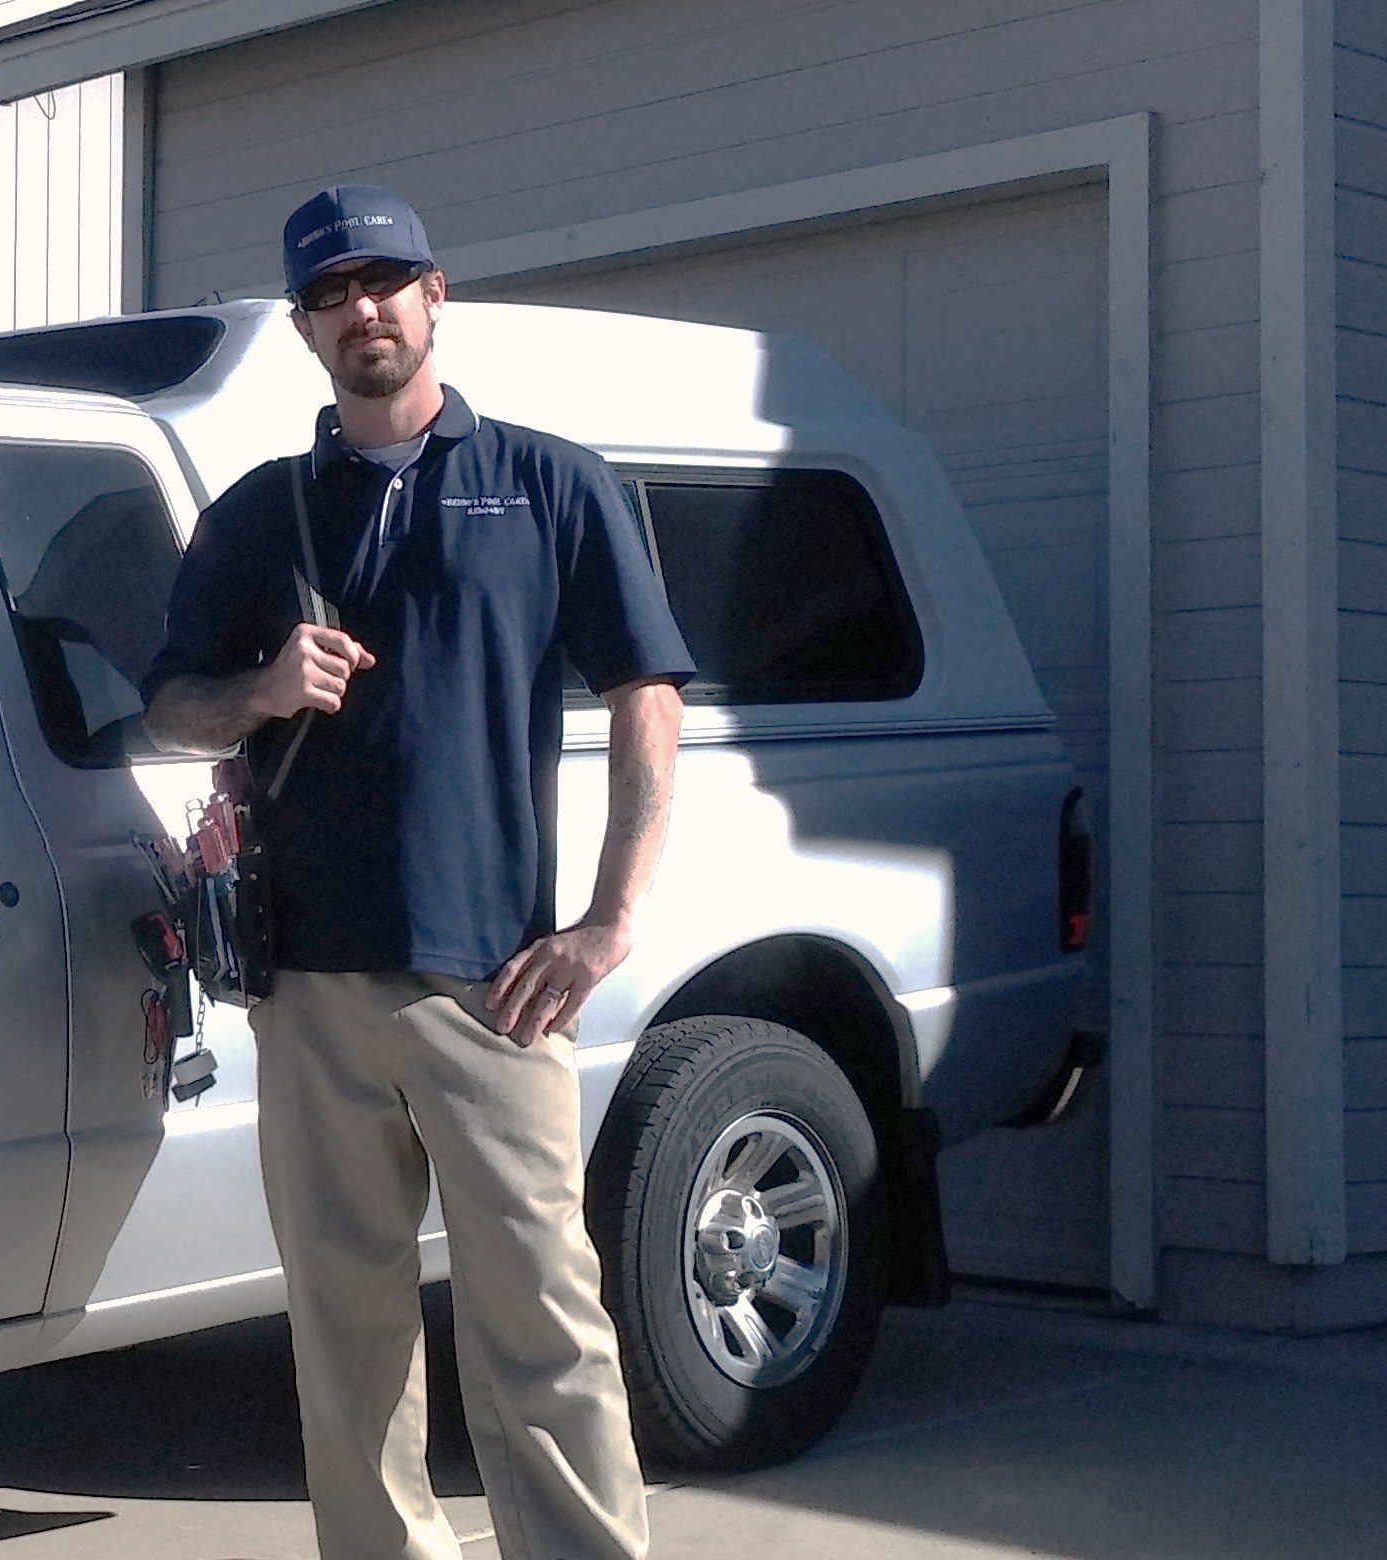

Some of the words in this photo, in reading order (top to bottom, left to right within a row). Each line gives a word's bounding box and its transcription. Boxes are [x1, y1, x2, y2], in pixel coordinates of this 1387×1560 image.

[333, 216, 359, 232] POOL
[363, 214, 388, 227] CARE
[480, 497, 502, 506] POOL
